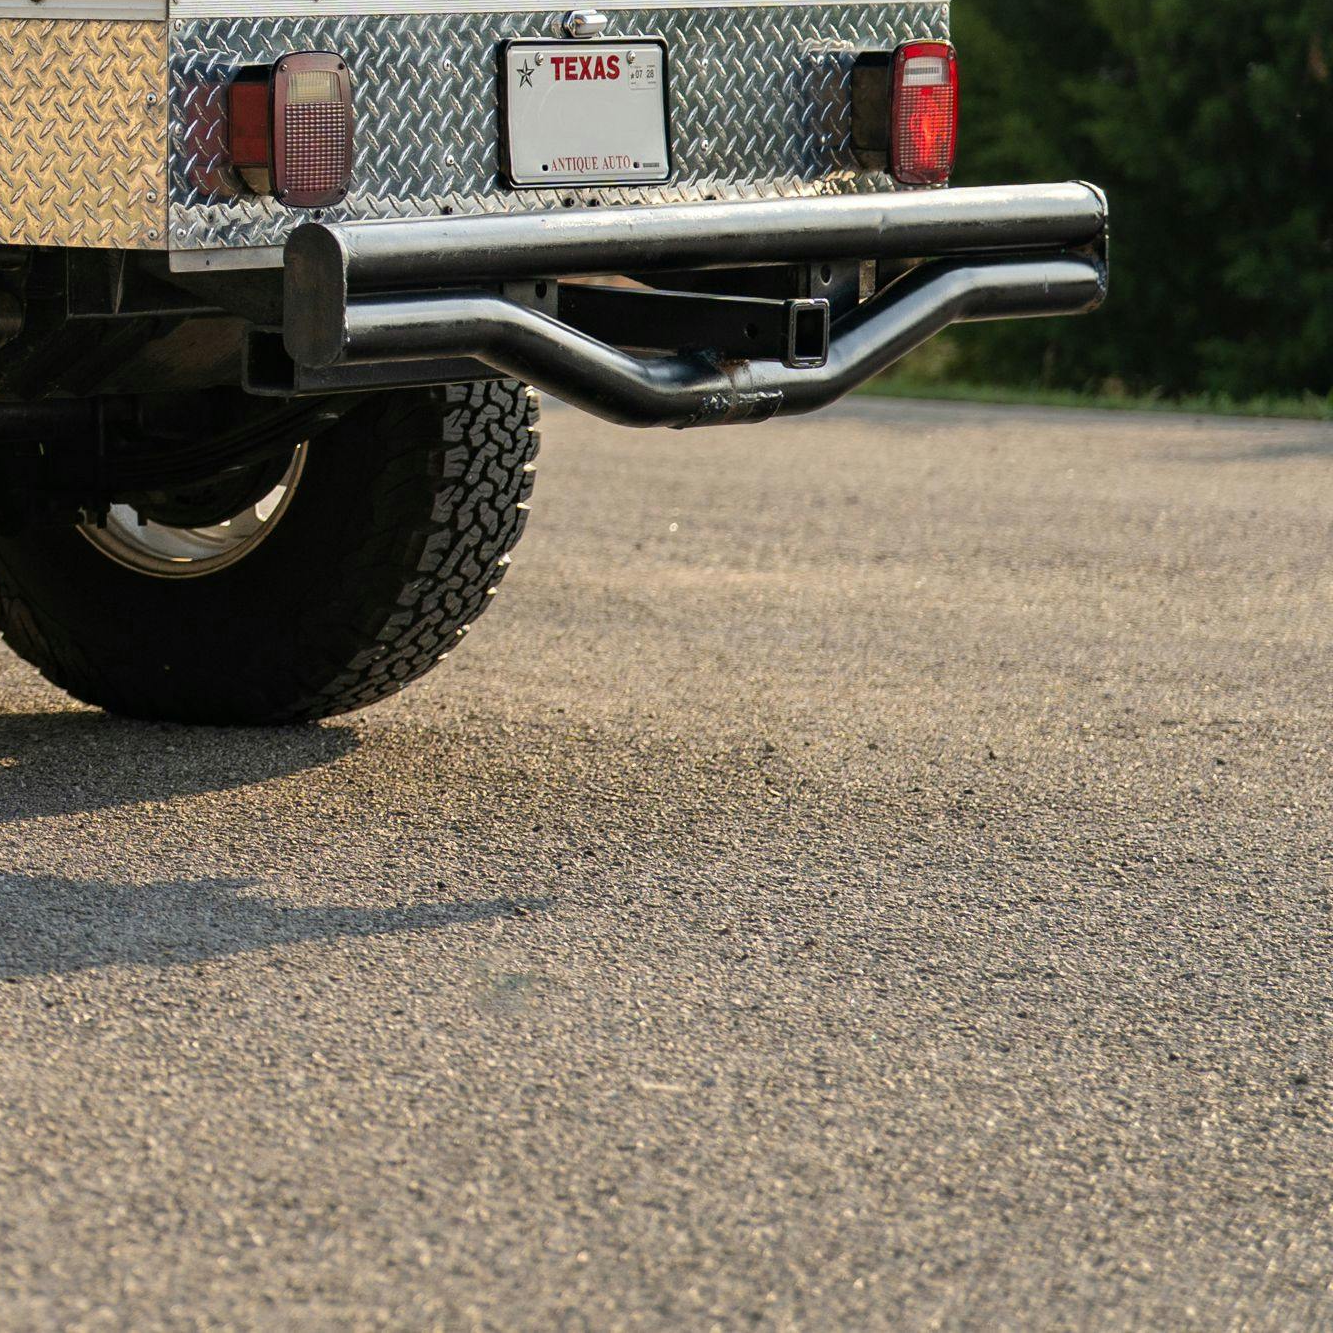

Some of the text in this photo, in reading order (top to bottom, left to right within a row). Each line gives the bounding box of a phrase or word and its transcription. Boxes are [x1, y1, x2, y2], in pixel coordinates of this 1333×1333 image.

[550, 54, 620, 81] TEXAS
[551, 155, 631, 173] ANTIQUE AUTO
